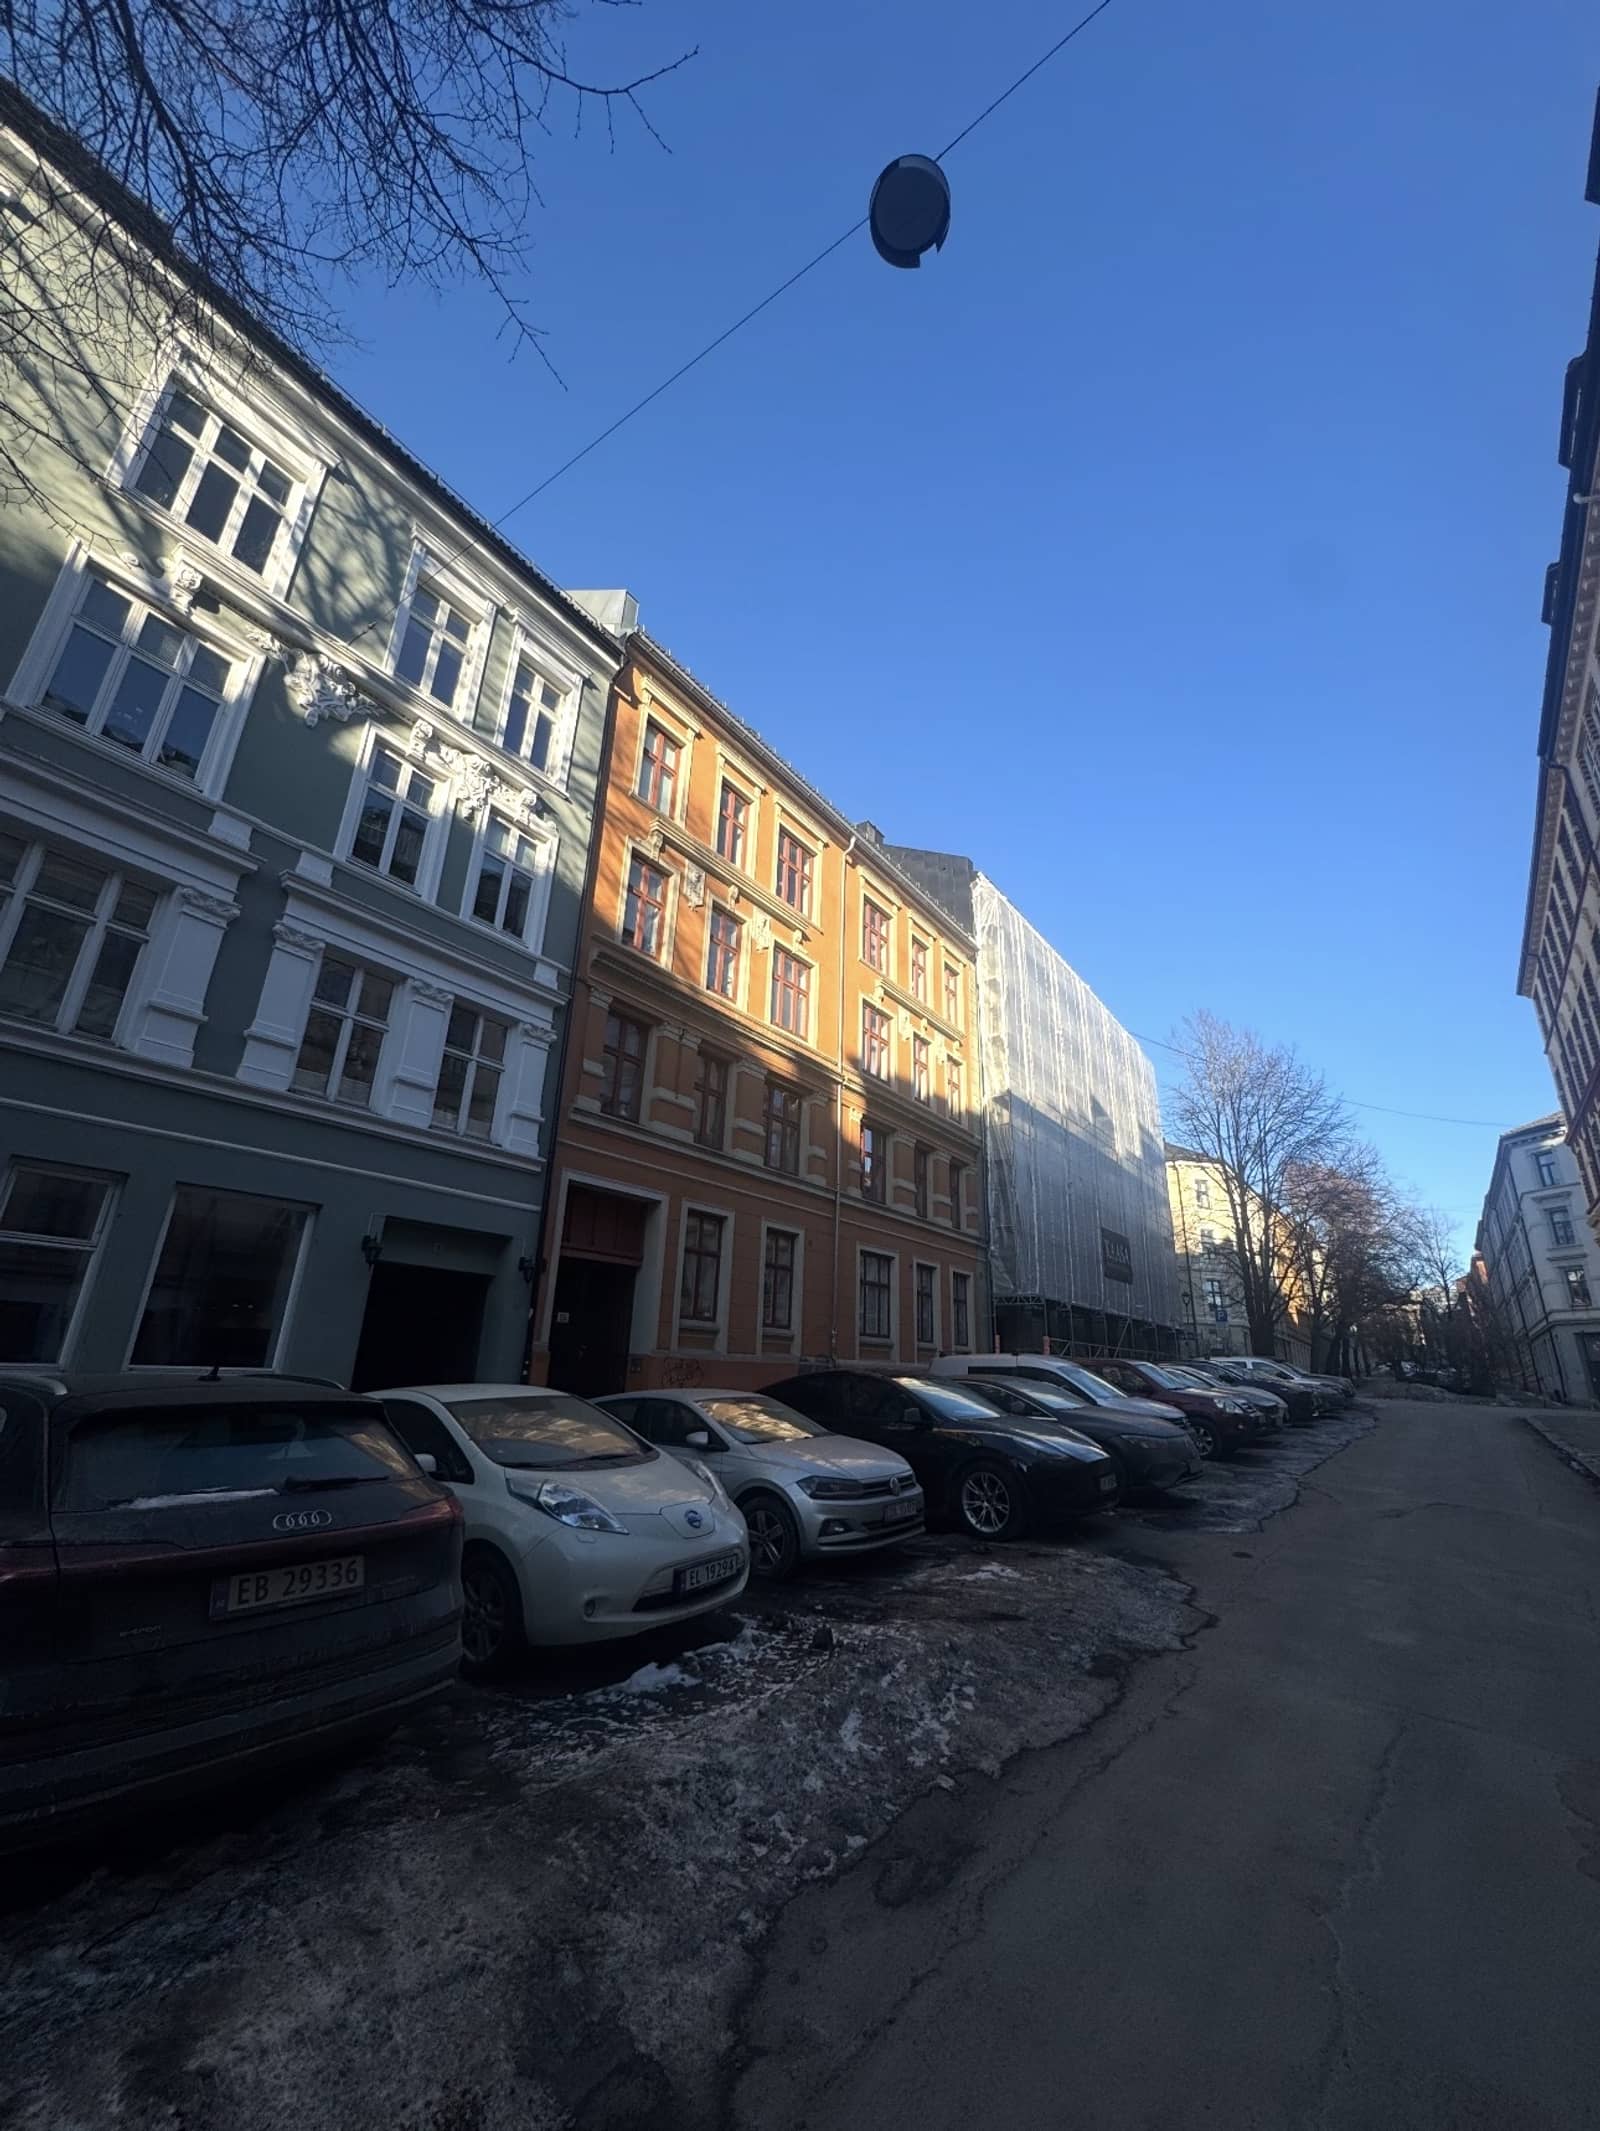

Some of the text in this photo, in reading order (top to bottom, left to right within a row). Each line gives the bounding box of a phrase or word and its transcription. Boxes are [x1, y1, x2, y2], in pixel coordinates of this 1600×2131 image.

[1218, 1311, 1225, 1320] P
[238, 1559, 357, 1605] EB 29336
[690, 1568, 701, 1586] EL
